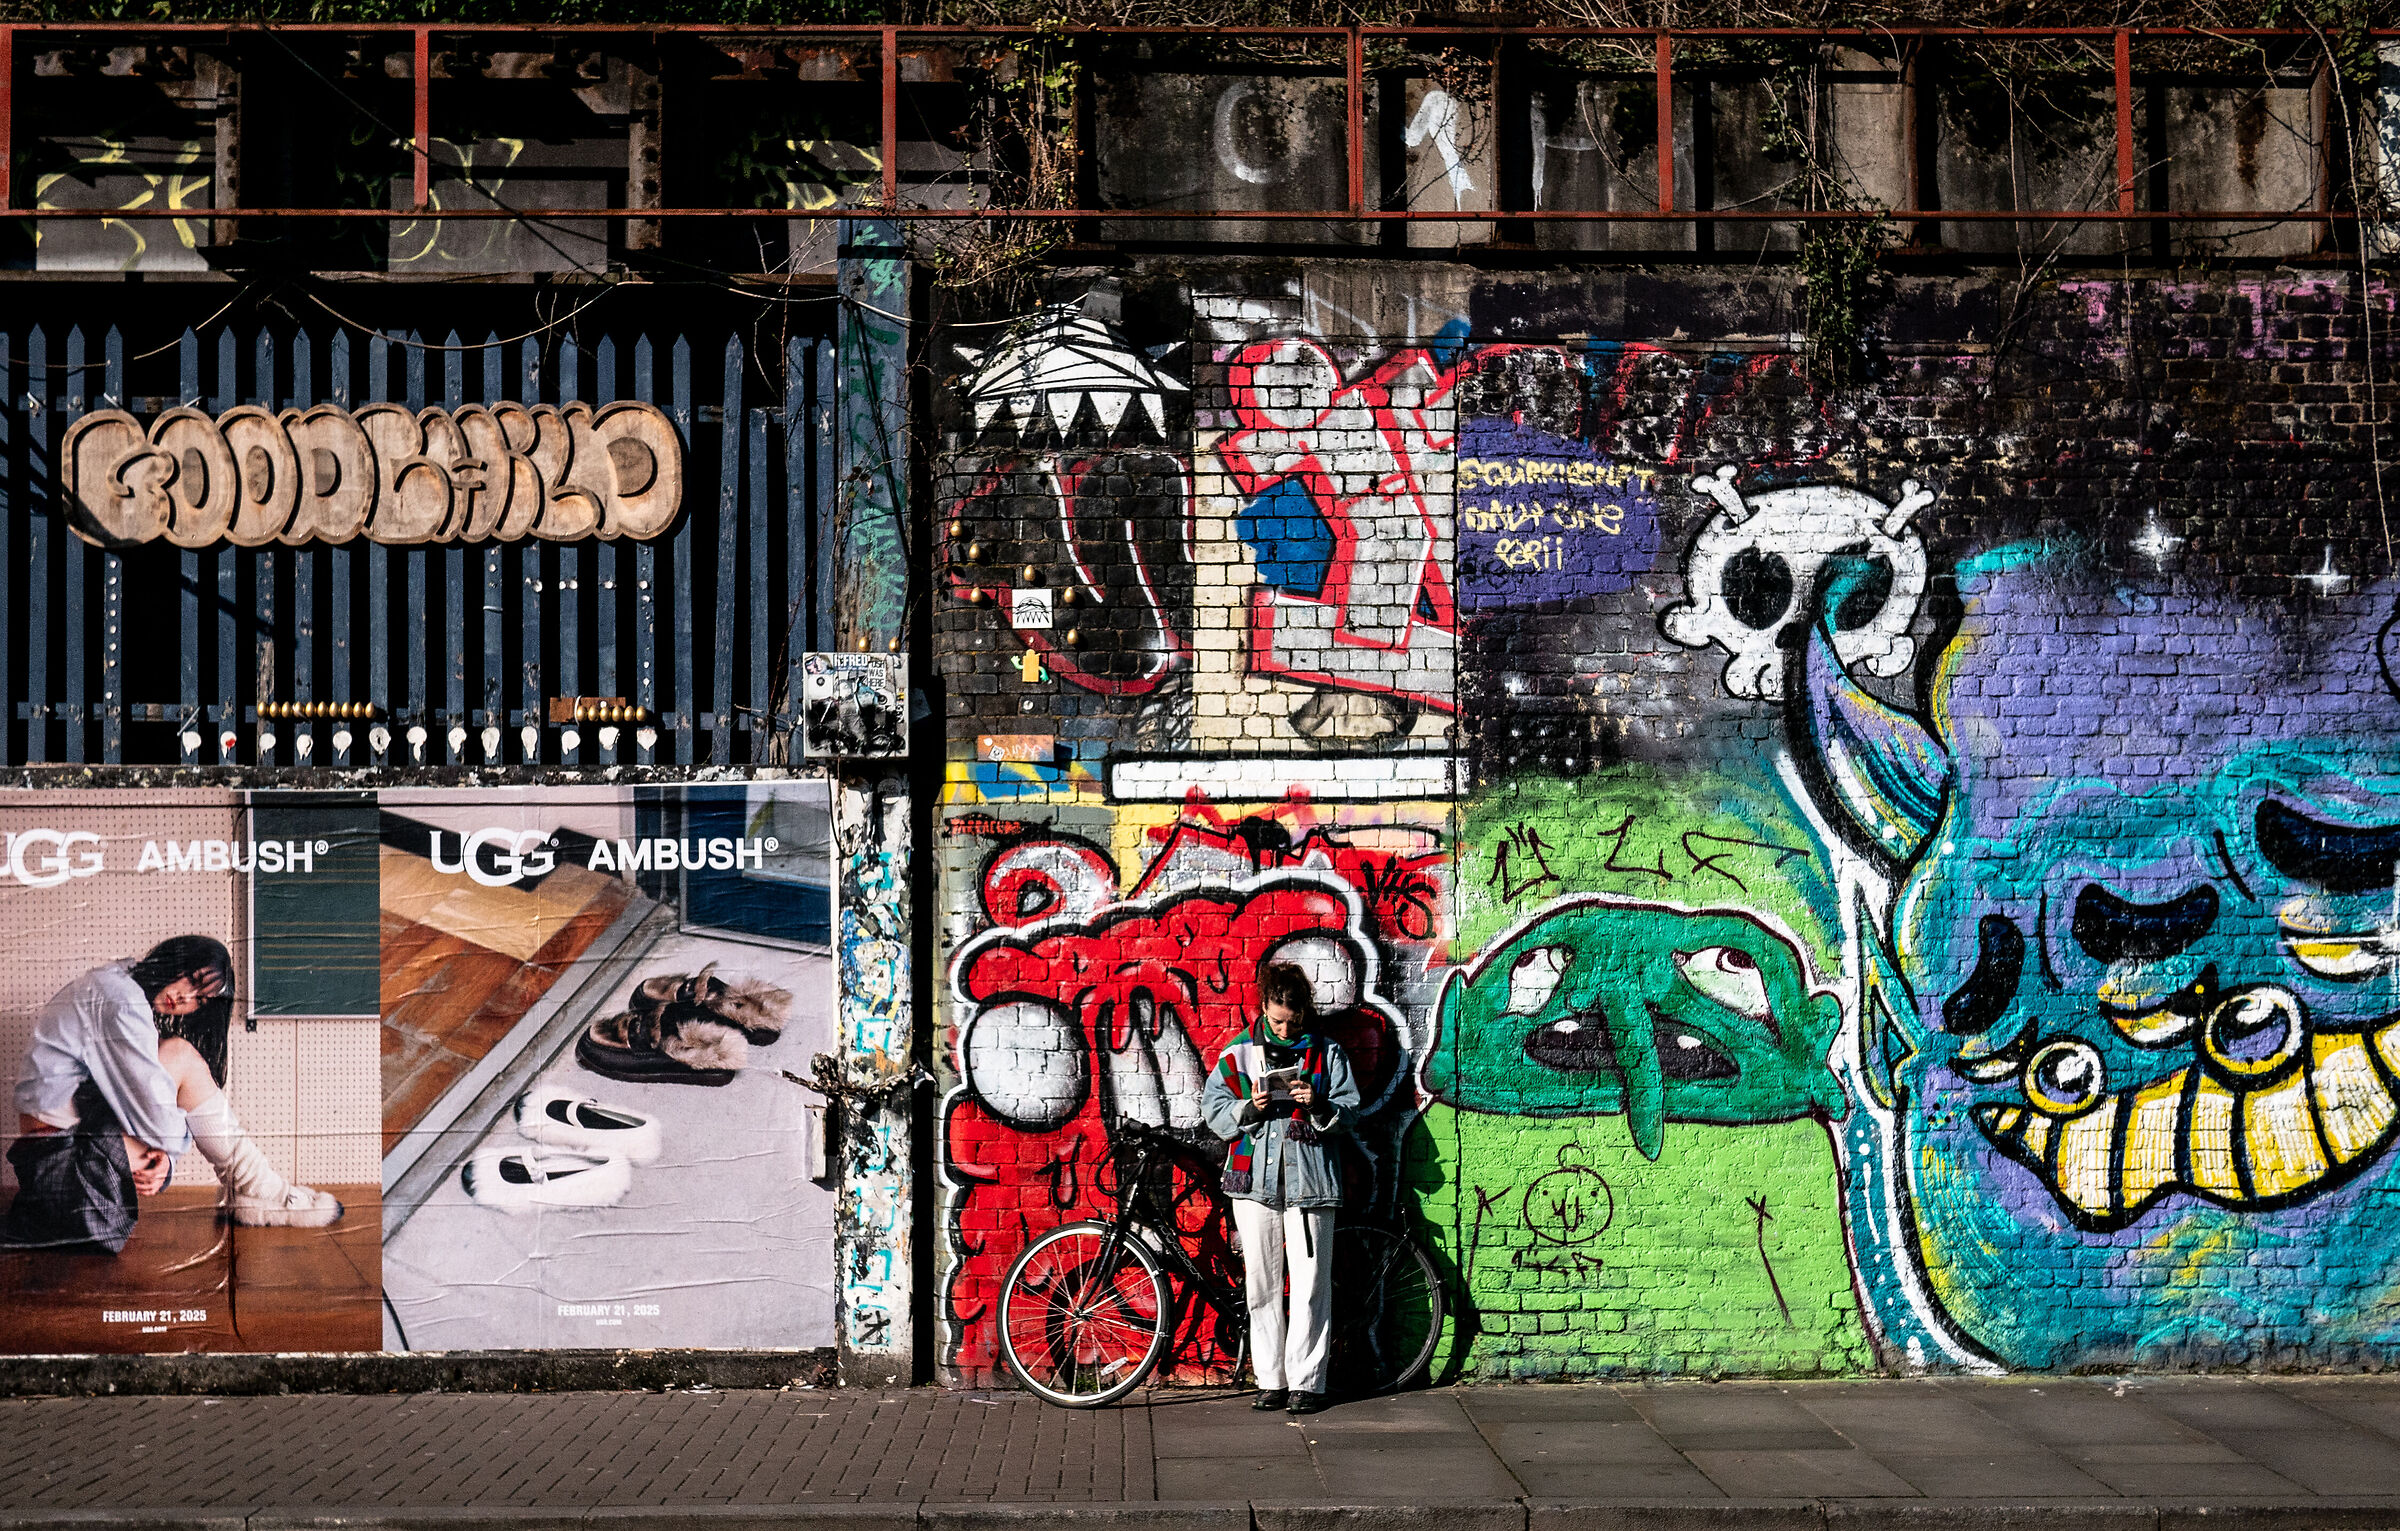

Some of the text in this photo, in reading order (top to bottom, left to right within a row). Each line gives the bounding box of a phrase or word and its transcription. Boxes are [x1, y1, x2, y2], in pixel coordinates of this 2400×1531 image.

[102, 1310, 157, 1323] FEBRUARY
[179, 1309, 207, 1322] 2025
[558, 1304, 611, 1316] FEBRUARY
[633, 1304, 660, 1316] 2025
